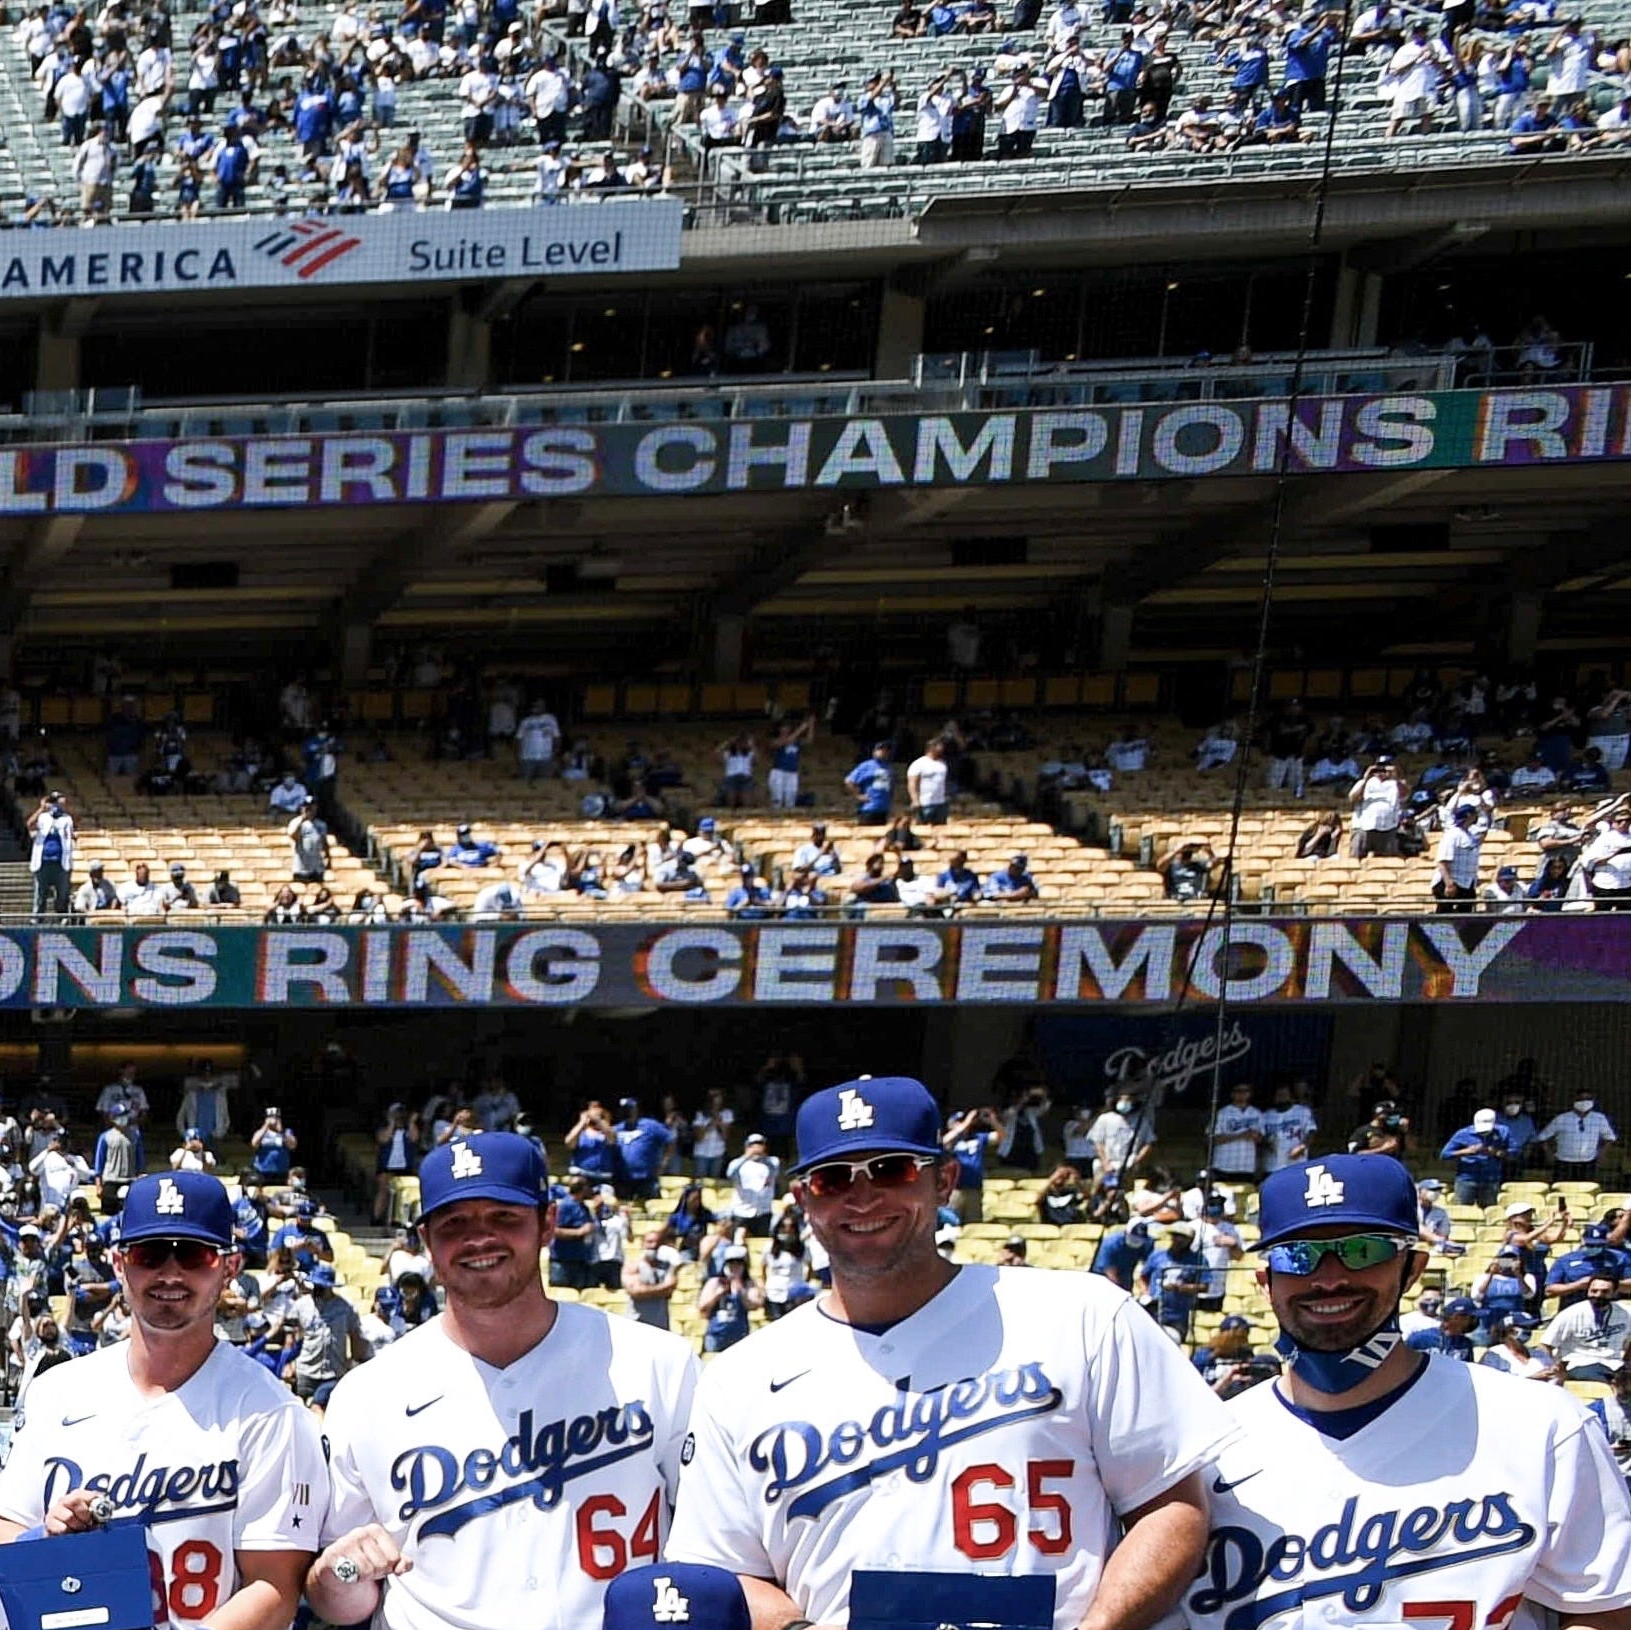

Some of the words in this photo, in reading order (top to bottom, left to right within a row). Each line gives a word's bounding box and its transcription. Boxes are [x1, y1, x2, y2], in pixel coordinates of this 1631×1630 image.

[2, 247, 237, 290] AMERICA
[409, 238, 506, 273] Suite
[522, 231, 621, 267] Level
[163, 426, 599, 509] SERIES
[635, 394, 1438, 490] CHAMPIONS
[261, 928, 602, 1003] RING
[642, 920, 1527, 1004] CEREMONY
[838, 1089, 873, 1130] LA
[450, 1138, 482, 1179] LA
[1305, 1165, 1343, 1206] LA
[157, 1179, 183, 1214] LA
[749, 1360, 1062, 1506] Dodgers
[43, 1452, 240, 1530] Dodgers
[291, 1482, 311, 1505] VII
[391, 1400, 654, 1530] Dodgers
[576, 1486, 660, 1580] 64
[951, 1459, 1074, 1560] 65
[1192, 1491, 1535, 1616] Dodgers
[653, 1578, 689, 1621] LA
